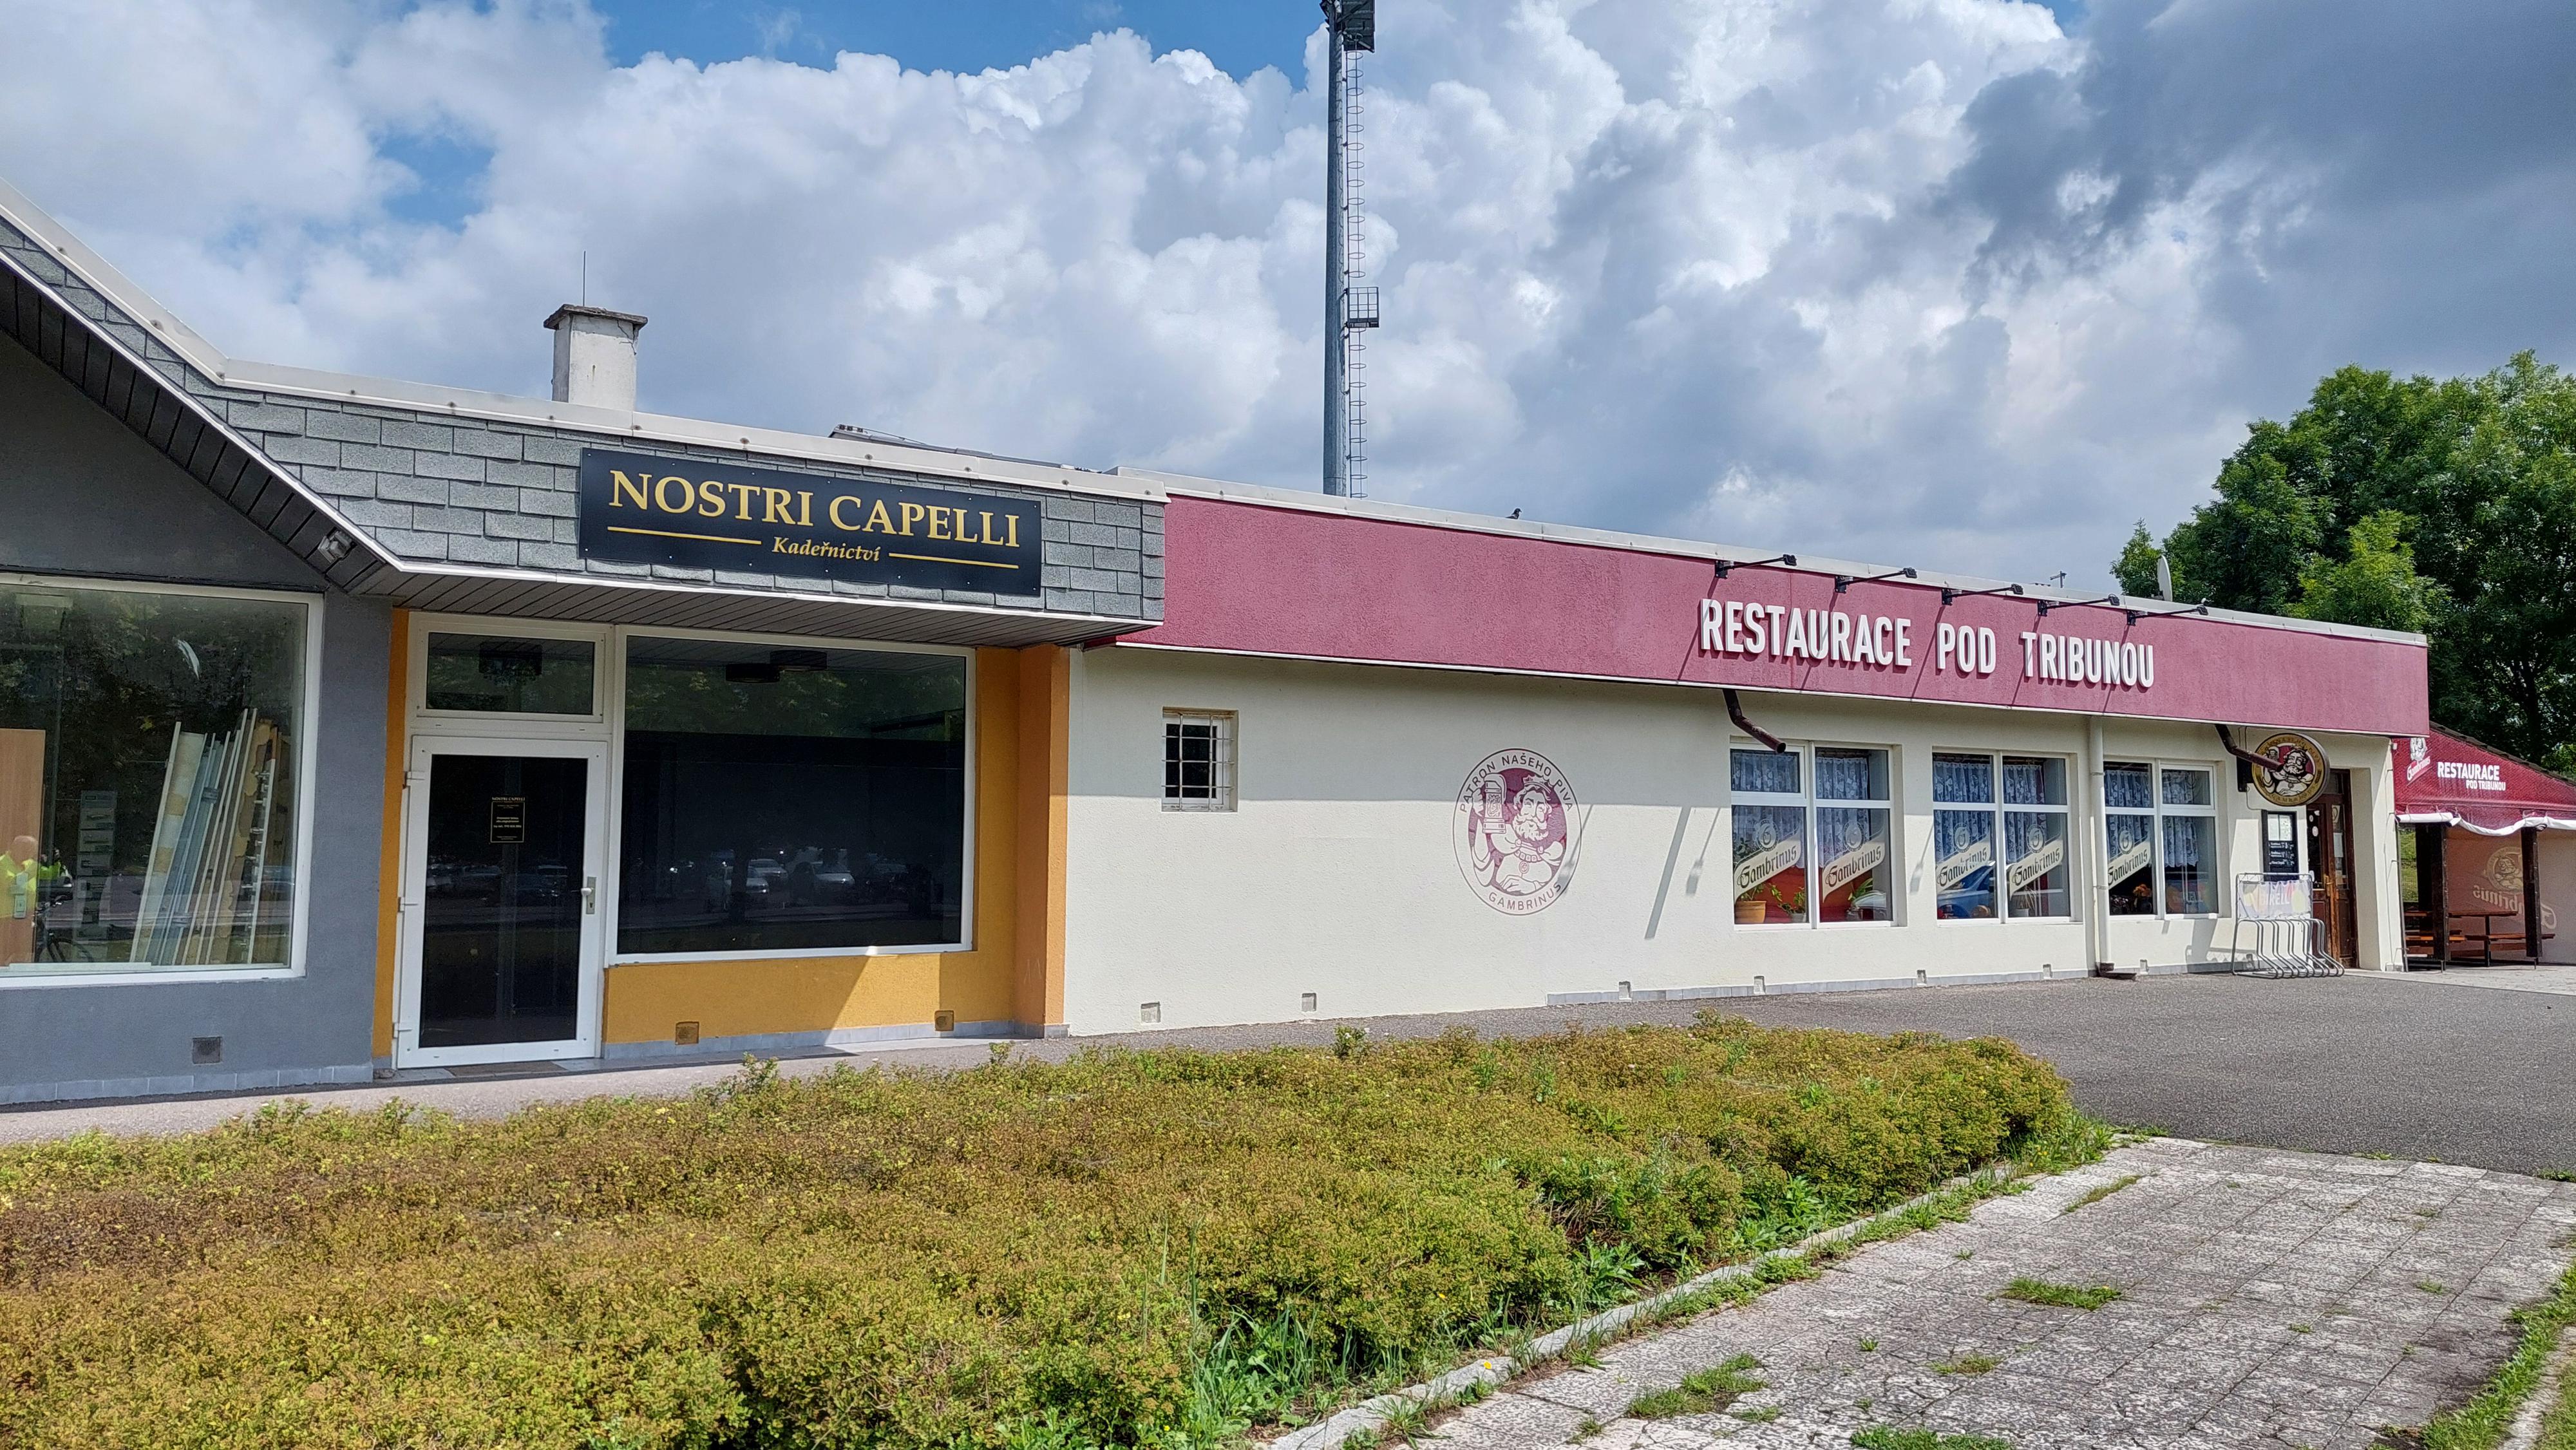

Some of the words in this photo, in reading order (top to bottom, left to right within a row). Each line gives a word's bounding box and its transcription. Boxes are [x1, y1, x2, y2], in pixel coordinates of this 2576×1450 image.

[609, 469, 815, 527] NOSTRI
[829, 495, 1020, 548] CAPELLI
[772, 537, 880, 562] Kadeřnictví
[1700, 599, 1912, 667] RESTAURACE
[1937, 622, 1996, 674] POD
[2020, 631, 2154, 688] TRIBUNOU
[1460, 761, 1495, 813] PATRON
[1502, 752, 1552, 777] NAŠEHO
[1555, 779, 1575, 812] PIVA
[2438, 762, 2500, 780] RESTAURACE
[2466, 780, 2477, 789] POD
[1737, 846, 1797, 889] Gambrinus
[1825, 850, 1881, 887] Gambrinus
[2012, 847, 2060, 886] Gambrinus
[1488, 883, 1562, 910] GAMBRINUS
